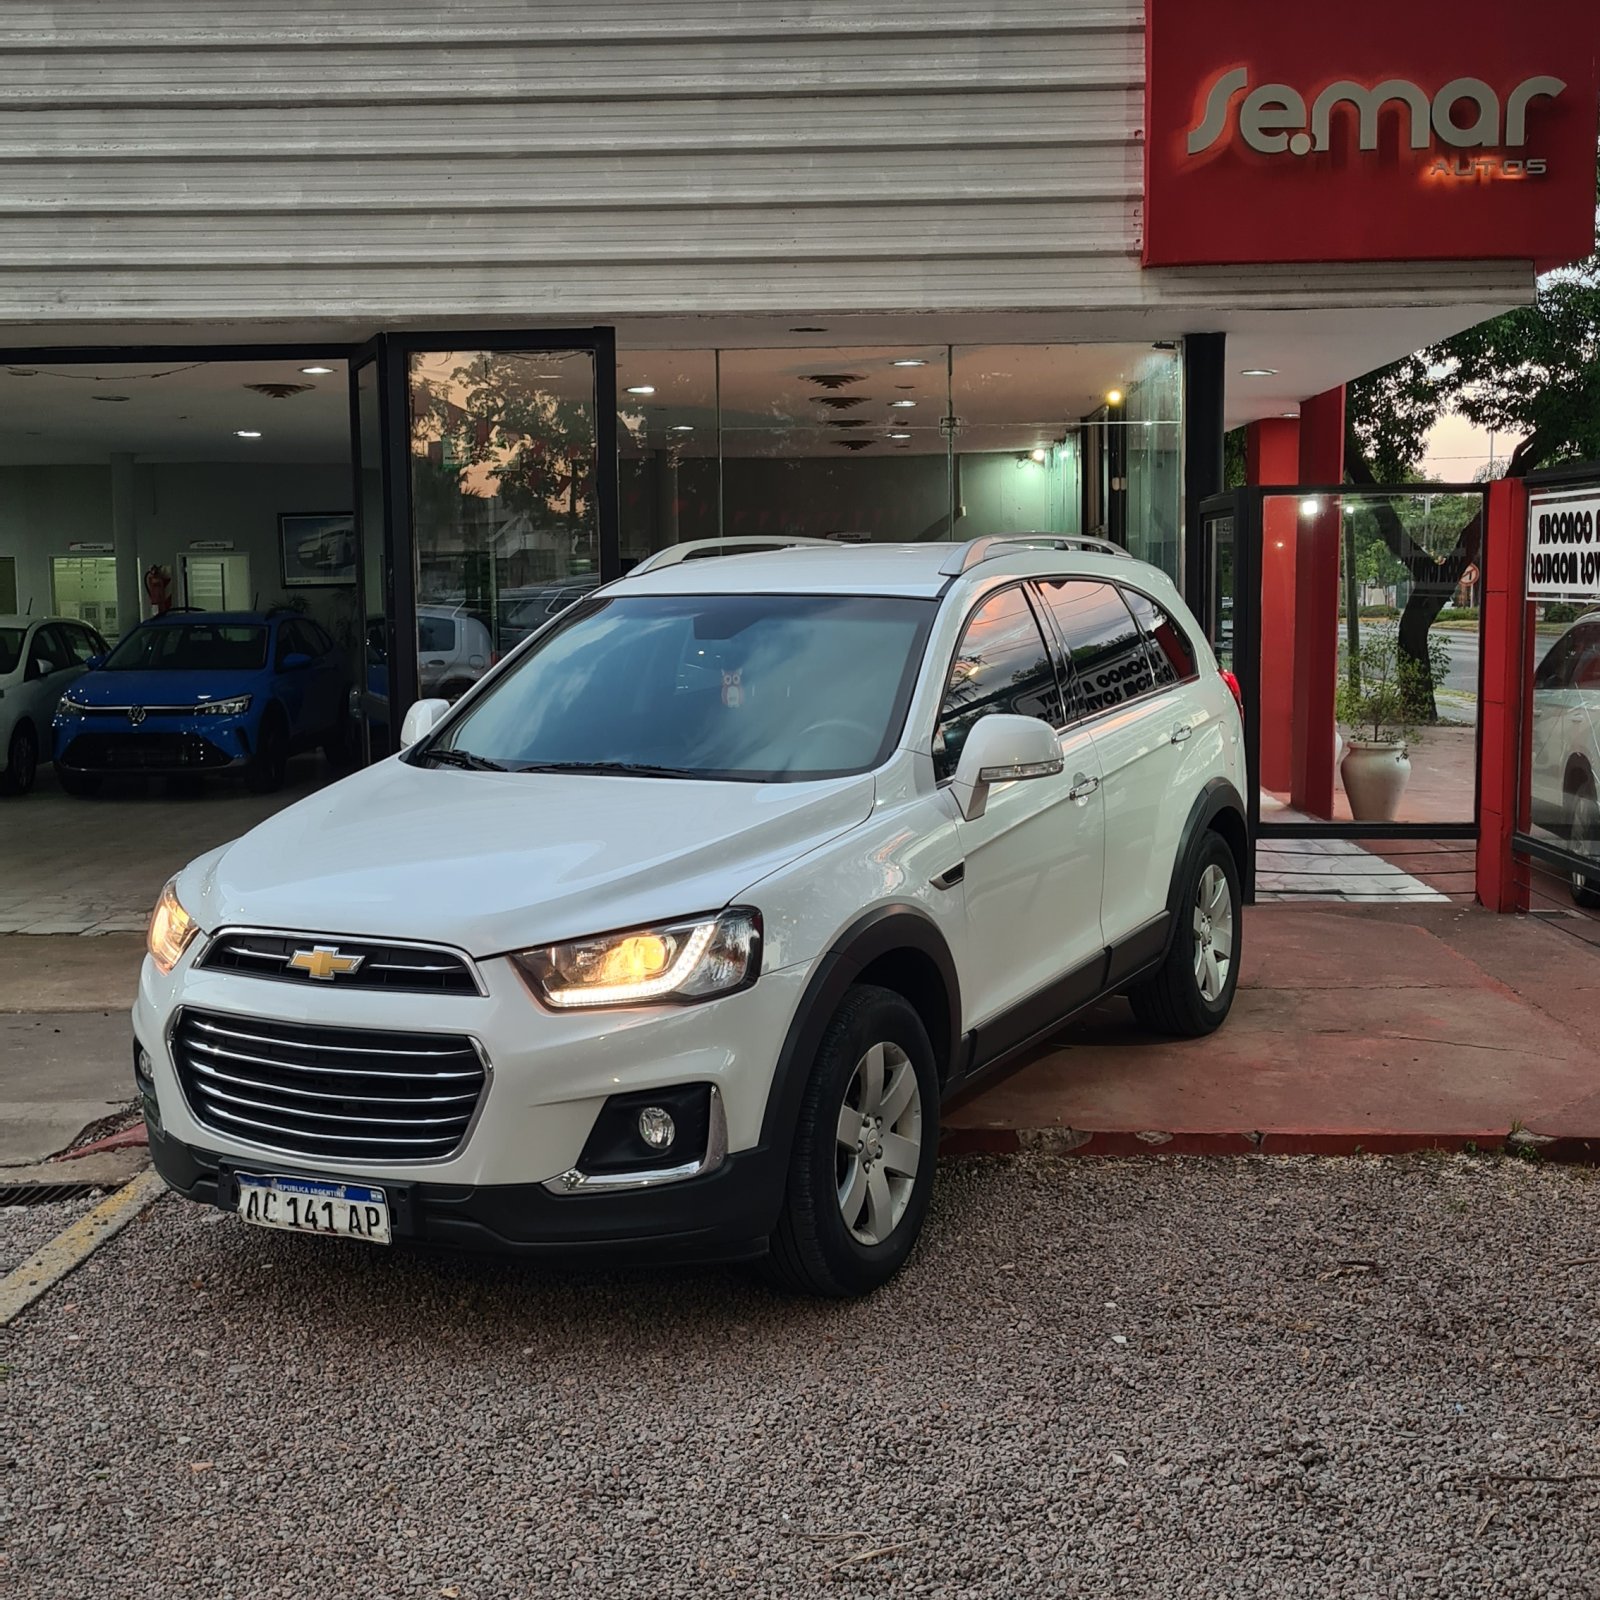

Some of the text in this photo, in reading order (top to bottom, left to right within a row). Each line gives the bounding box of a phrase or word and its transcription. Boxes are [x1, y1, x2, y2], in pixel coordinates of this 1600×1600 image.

[1430, 158, 1548, 176] AUTOS
[287, 1197, 337, 1234] 141
[349, 1204, 380, 1236] AP
